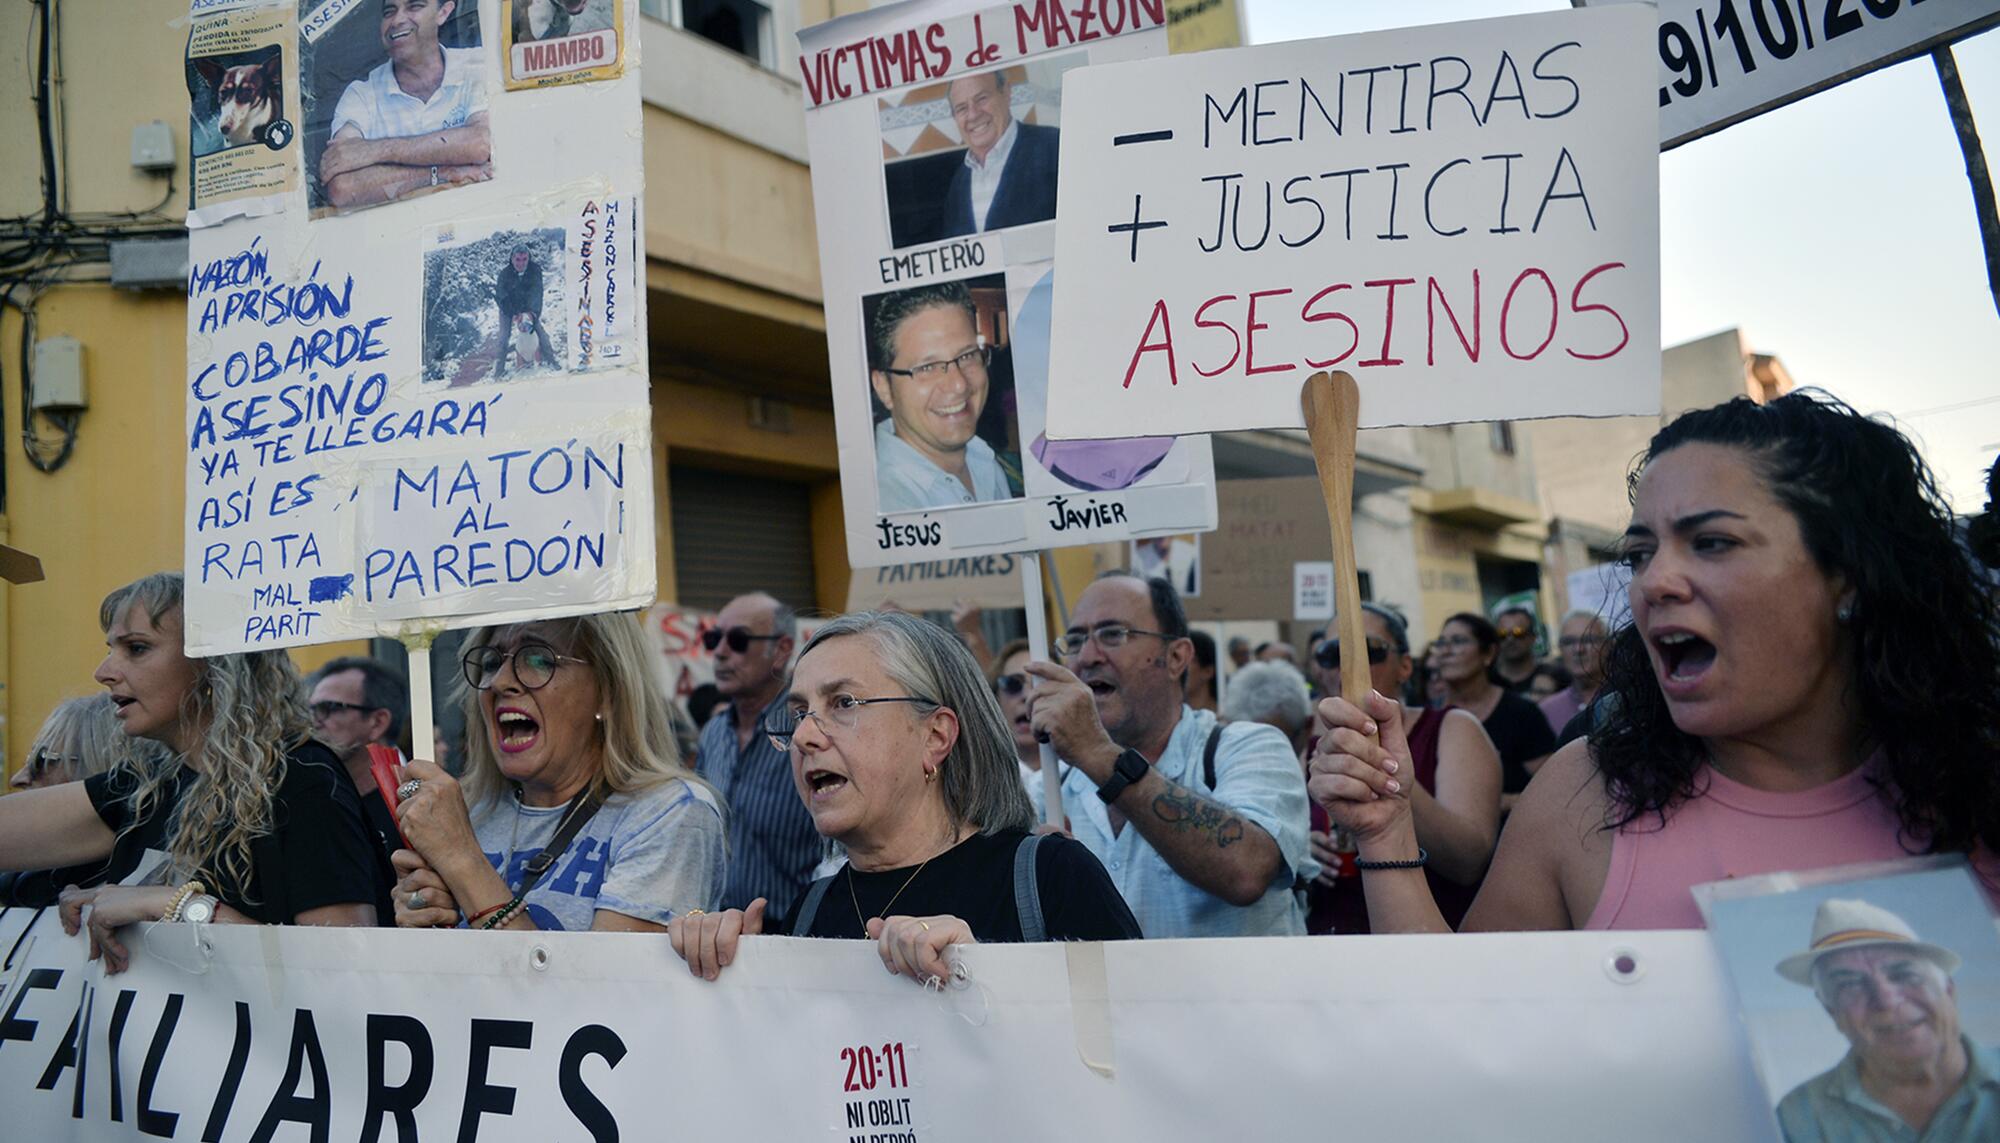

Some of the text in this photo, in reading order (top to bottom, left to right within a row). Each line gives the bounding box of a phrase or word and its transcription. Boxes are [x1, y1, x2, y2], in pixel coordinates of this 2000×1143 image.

[192, 31, 230, 42] PERDIDA
[195, 18, 228, 33] QUINA
[965, 14, 1002, 67] de
[524, 36, 604, 71] MAMBO
[1204, 41, 1582, 149] MENTIRAS
[1198, 147, 1596, 253] JUSTICIA
[879, 239, 985, 284] EMETERIO
[1122, 262, 1629, 388] ASESINOS
[192, 317, 392, 400] COBARDE
[191, 372, 389, 451] ASESINO
[200, 393, 503, 485] YA TE LLEGARÁ
[394, 438, 623, 511] MATÓN
[198, 477, 256, 532] ASÍ
[453, 503, 510, 537] AL
[876, 496, 1128, 549] JESÚS JAVIER
[202, 533, 321, 584] RATA
[365, 520, 604, 602] PAREDÓN
[253, 584, 302, 610] MAL
[244, 607, 321, 643] PARIT
[841, 1042, 908, 1092] 20:11
[846, 1098, 911, 1128] NI OBLIT
